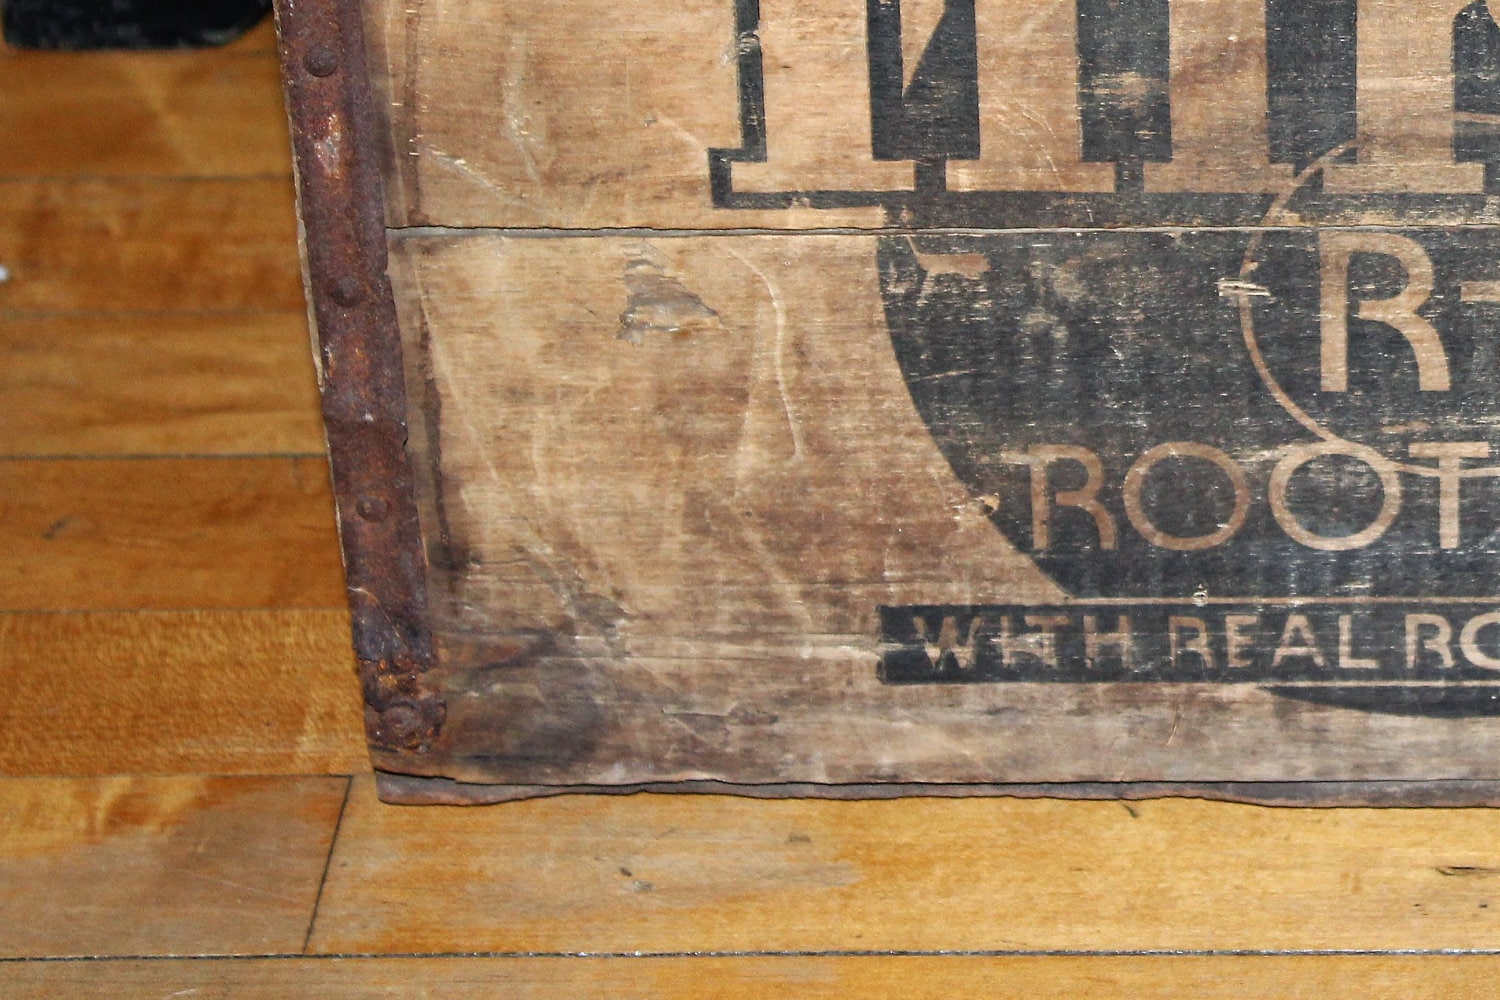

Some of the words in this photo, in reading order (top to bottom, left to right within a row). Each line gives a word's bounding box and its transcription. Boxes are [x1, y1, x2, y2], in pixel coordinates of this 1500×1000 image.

[1003, 440, 1490, 551] ROOT
[913, 614, 1133, 669] WITH
[1168, 613, 1378, 670] REAL
